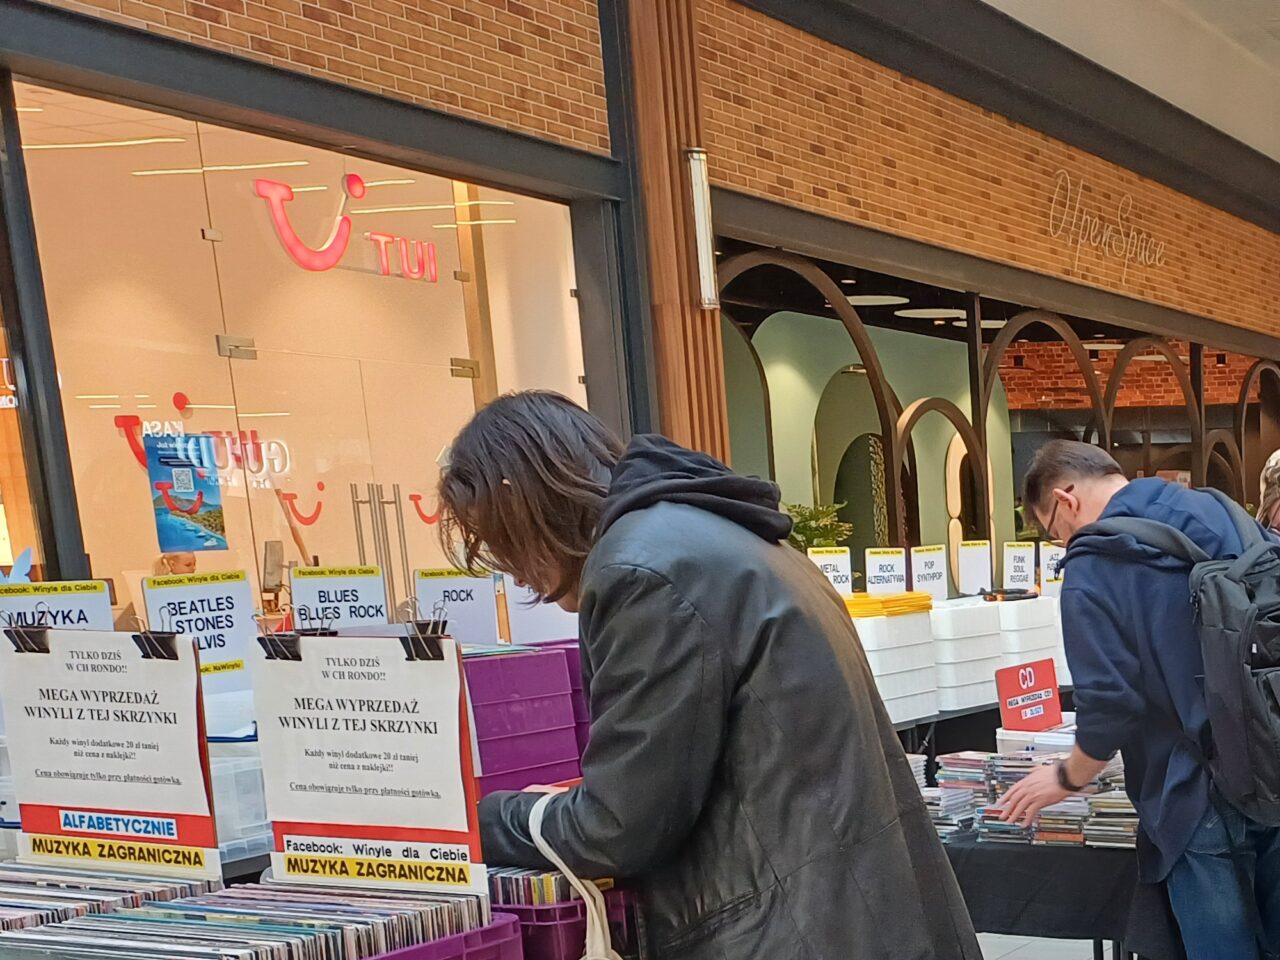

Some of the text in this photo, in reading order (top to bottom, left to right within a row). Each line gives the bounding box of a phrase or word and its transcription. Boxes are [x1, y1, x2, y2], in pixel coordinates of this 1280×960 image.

[370, 231, 437, 283] TUI
[924, 561, 935, 570] POP
[1013, 555, 1026, 564] FUNK
[879, 564, 895, 573] ROCK
[1013, 565, 1026, 573] SOUL
[833, 575, 850, 584] ROCK
[917, 572, 943, 583] SYNTHPOP
[1010, 574, 1029, 583] REGGAE
[0, 583, 98, 595] cebook: Winyle dla Ciebie
[318, 589, 359, 603] BLUES
[443, 588, 474, 602] ROCK
[167, 596, 235, 616] BEATLES
[298, 604, 384, 621] BLUES ROCK
[8, 609, 89, 627] MUZYKA
[175, 614, 235, 635] STONES
[195, 633, 226, 650] LVIS
[69, 650, 122, 661] TYLKO DZIŚ
[325, 657, 380, 668] TYLKO DZIŚ
[65, 663, 128, 674] W CH RONDO!!
[321, 671, 386, 681] W CH RONDO!!
[1018, 667, 1035, 690] CD
[39, 688, 160, 706] MEGA WYPRZEDAŻ
[294, 697, 420, 714] MEGA WYPRZEDAŻ
[24, 706, 178, 725] WINYLI Z TEJ SKRZYNKI
[278, 716, 438, 735] WINYLI Z TEJ SKRZYNKI
[62, 812, 175, 837] ALFABETYCZNIE
[32, 838, 203, 867] MUZYKA ZAGRANICZNA
[286, 840, 468, 862] Facebook: Winyle dla Ciebie
[287, 858, 468, 884] MUZYKA ZAGRANICZNA
